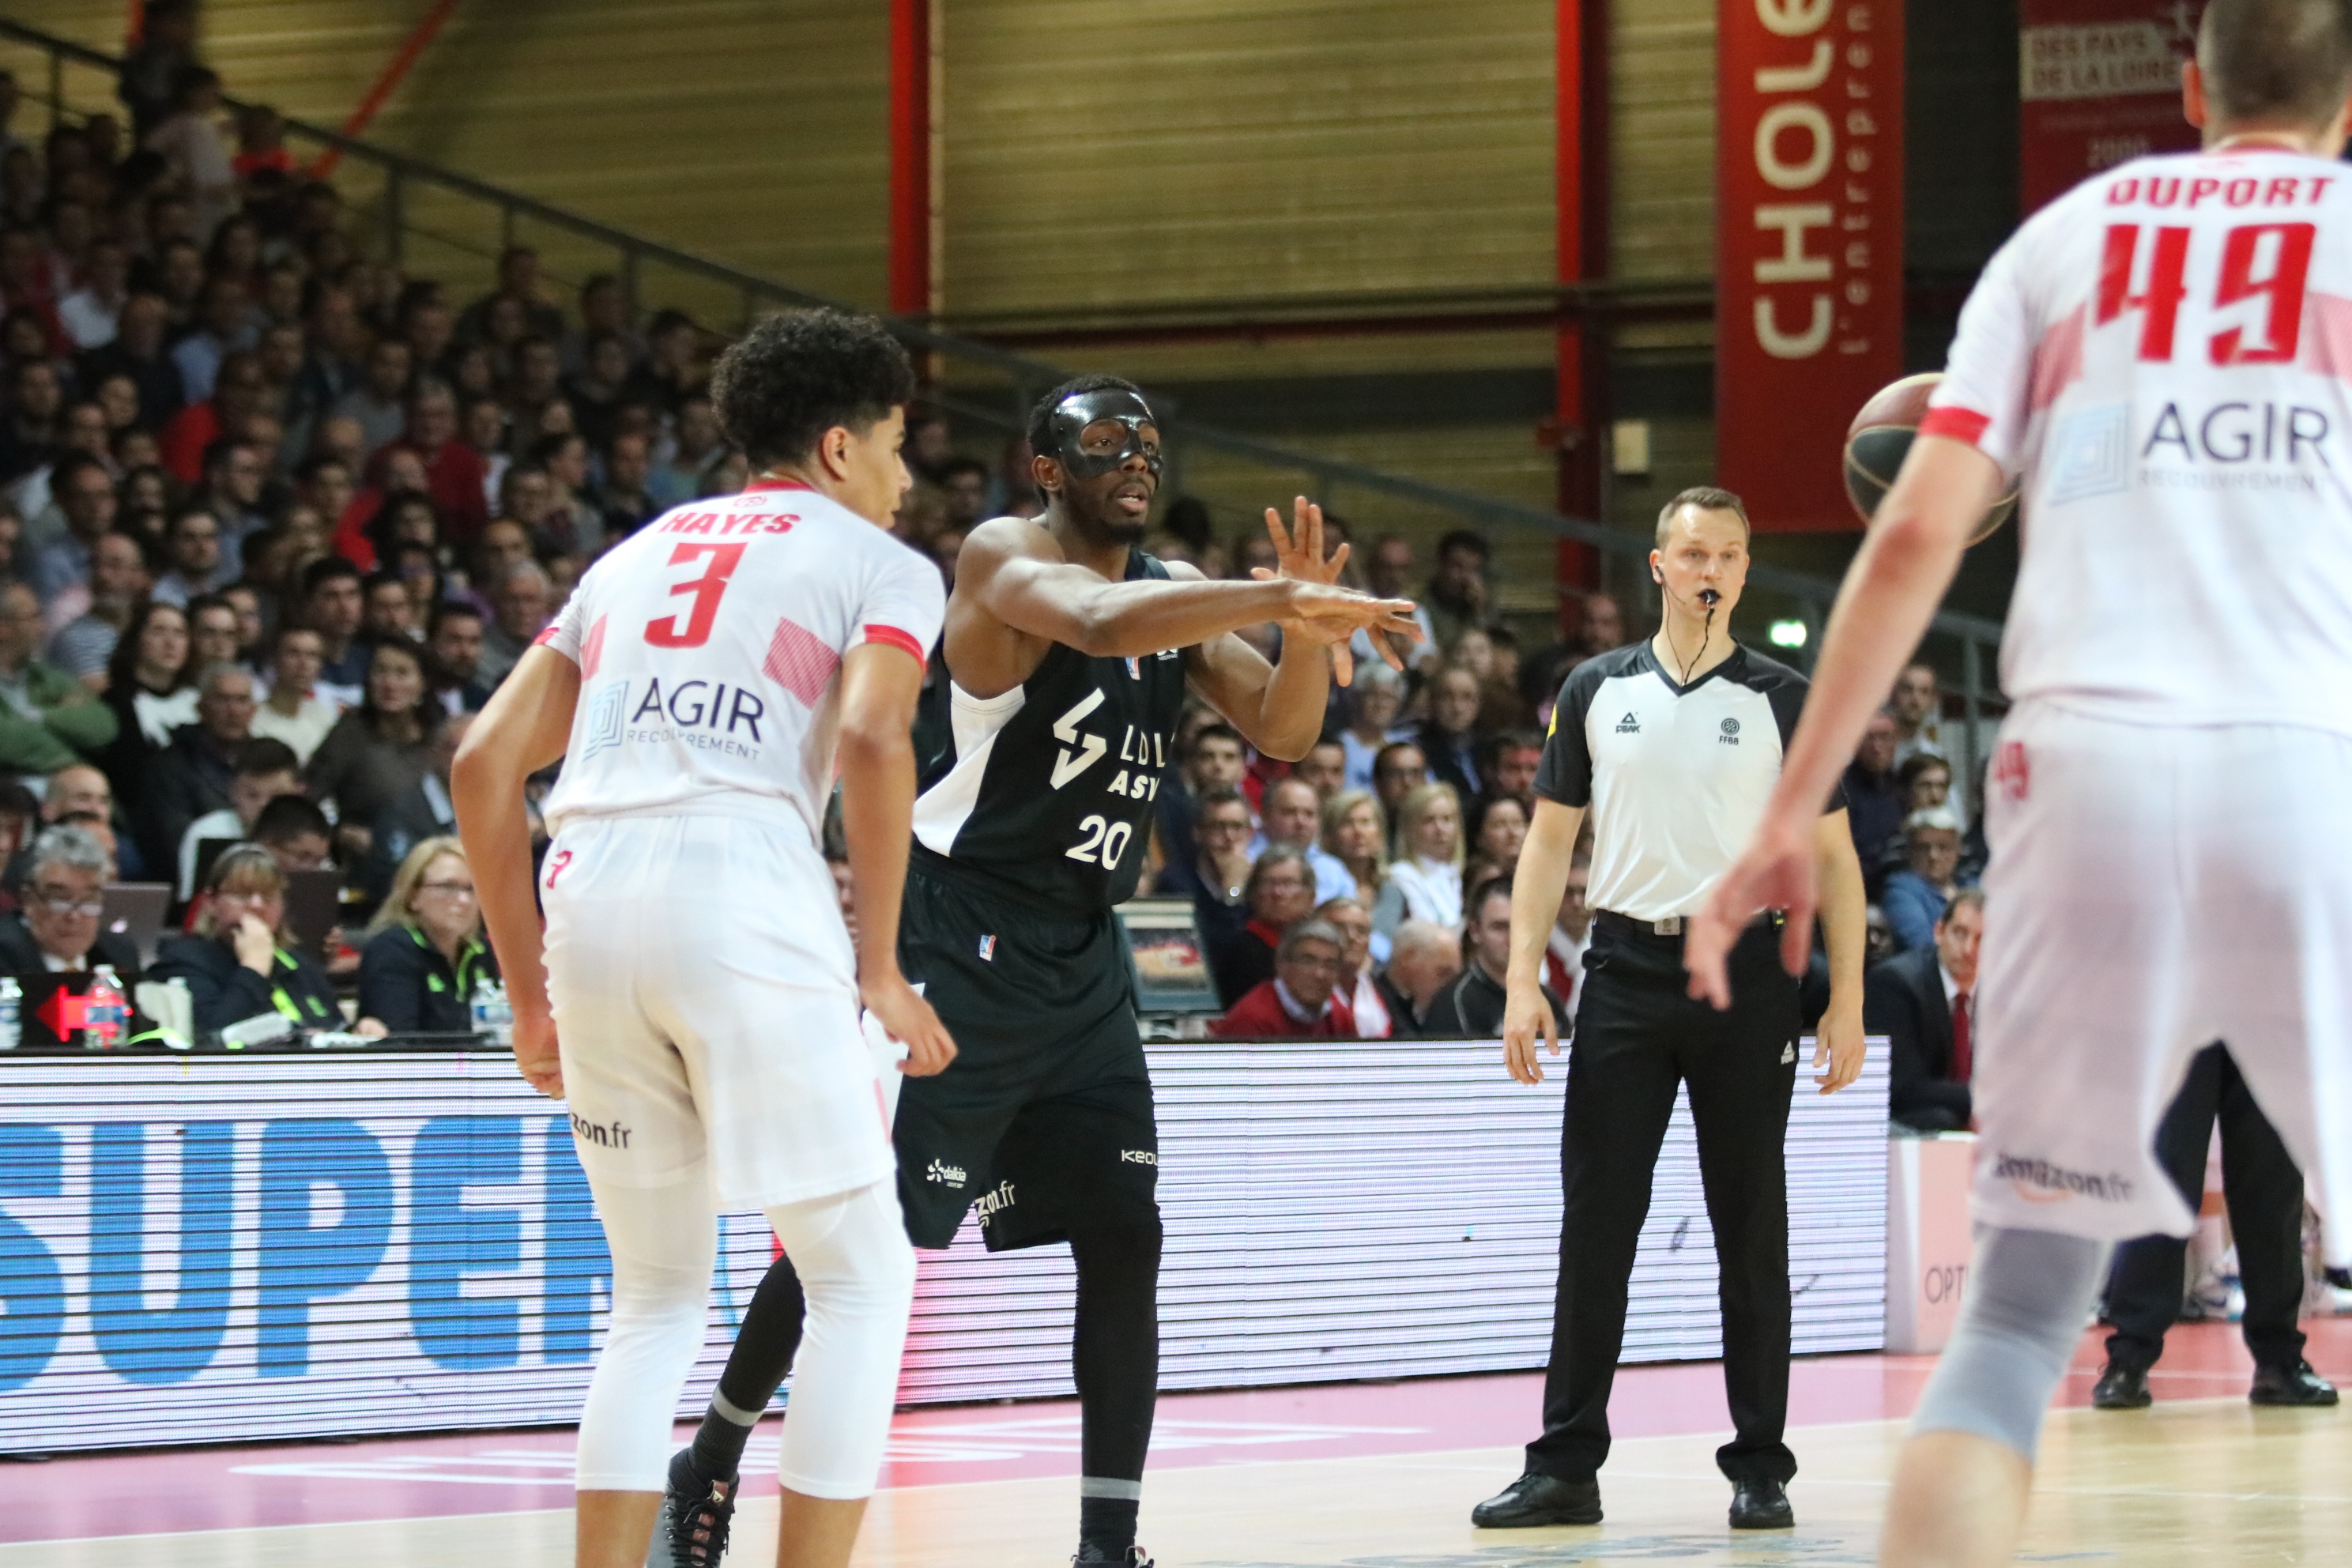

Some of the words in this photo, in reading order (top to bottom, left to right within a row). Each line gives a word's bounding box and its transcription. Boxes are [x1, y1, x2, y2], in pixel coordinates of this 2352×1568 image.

[2105, 176, 2336, 209] DUPORT
[2094, 222, 2316, 369] 49
[2140, 401, 2332, 468] AGIR
[658, 512, 802, 536] HAYES
[643, 542, 748, 648] 3
[631, 677, 764, 744] AGIR
[1615, 725, 1642, 733] PEAK
[1120, 725, 1175, 767] LDL
[1719, 735, 1739, 745] FFBB
[1065, 815, 1132, 871] 20
